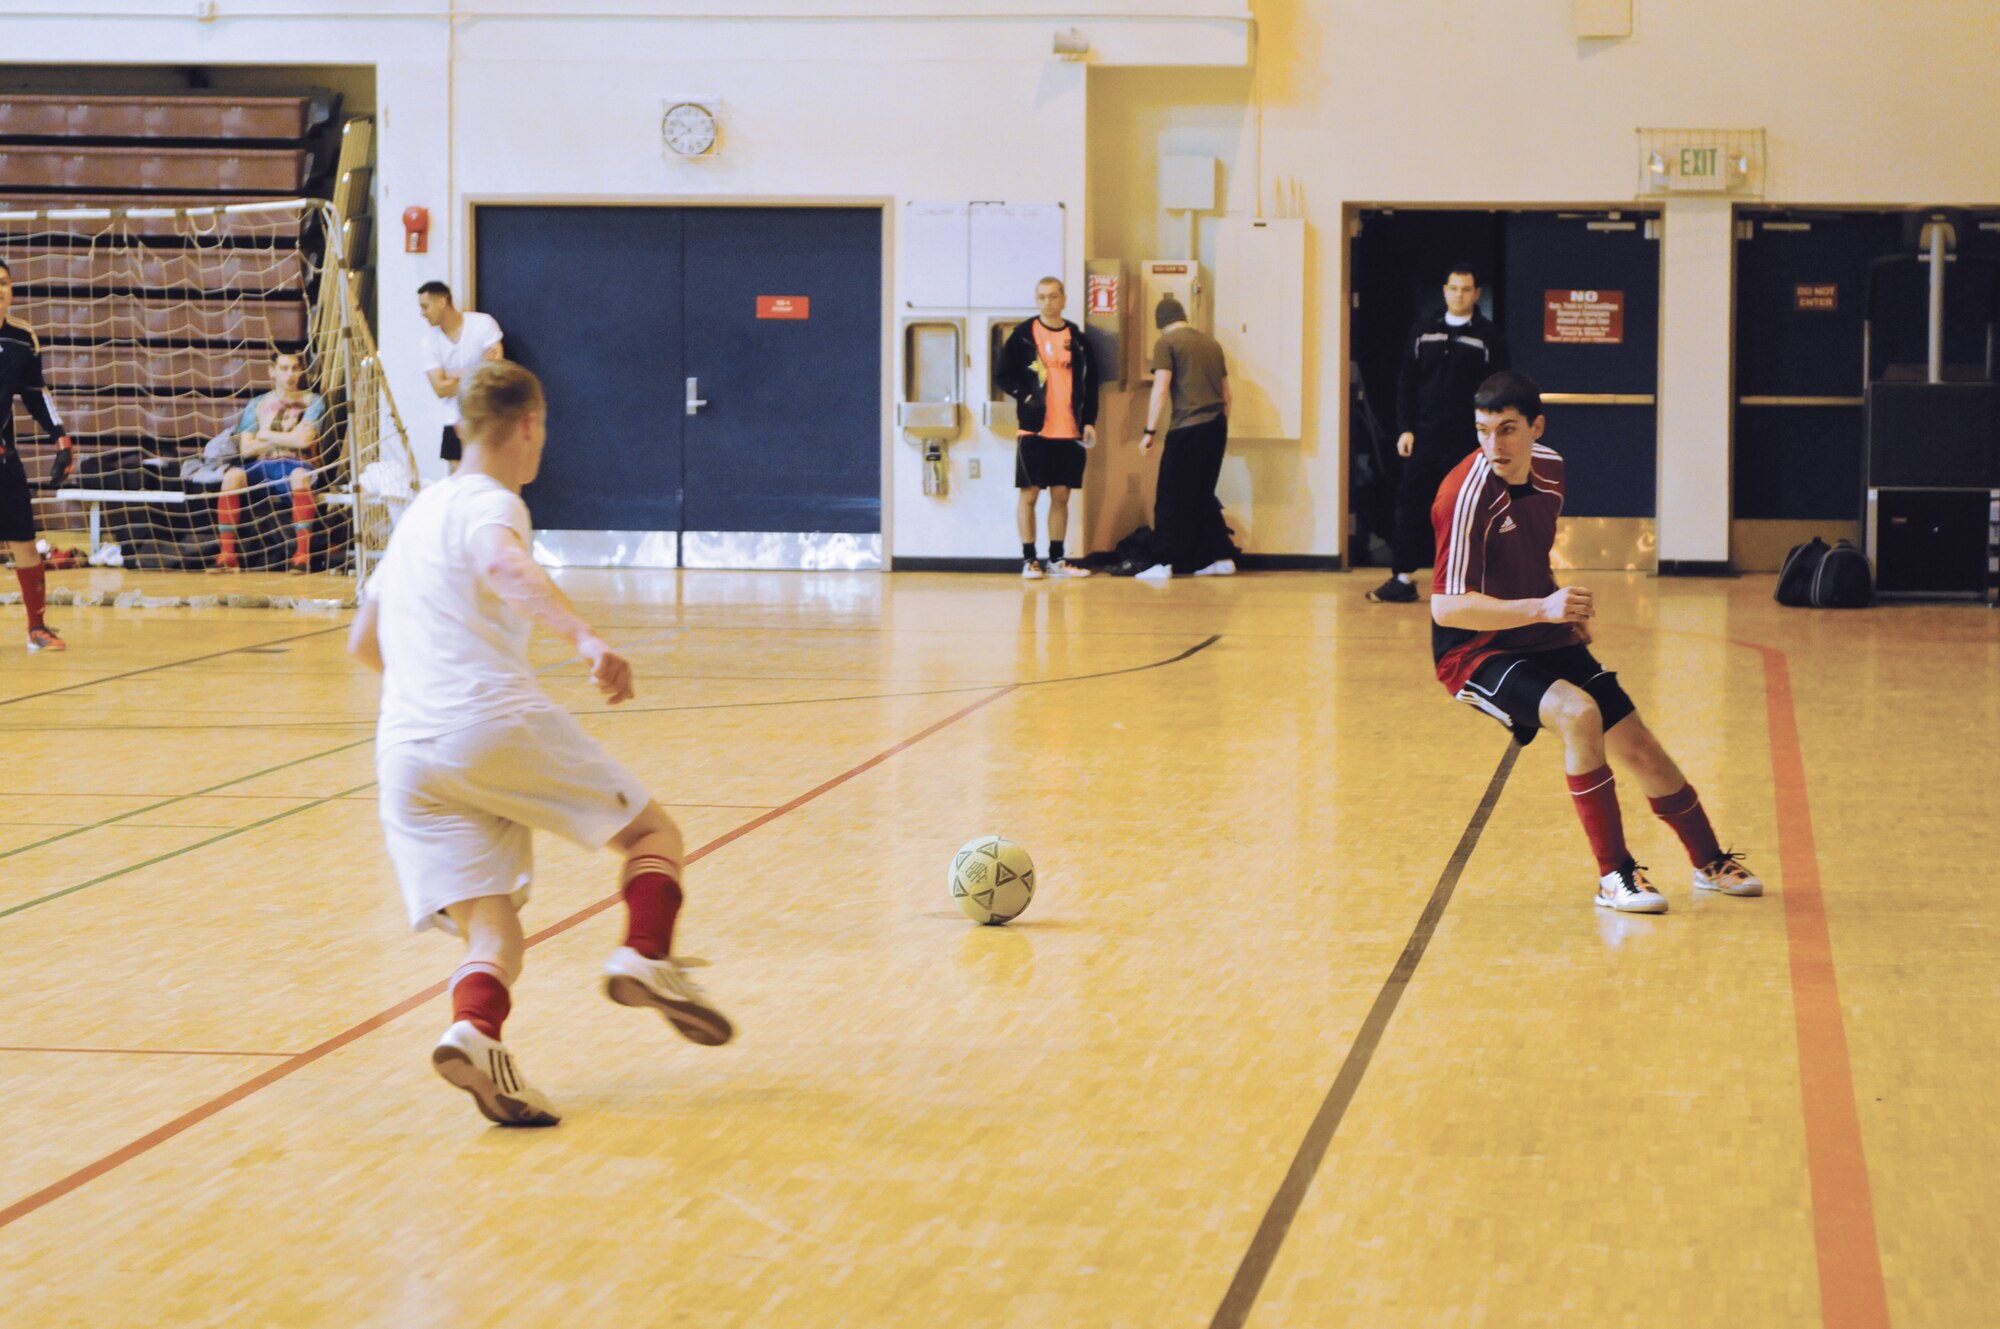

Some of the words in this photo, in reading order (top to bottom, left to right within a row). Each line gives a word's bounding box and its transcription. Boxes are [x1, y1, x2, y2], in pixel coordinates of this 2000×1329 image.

[1681, 148, 1717, 176] EXIT
[1570, 290, 1598, 302] NO
[1797, 286, 1813, 296] DO
[1814, 286, 1834, 296] NOT
[1799, 298, 1832, 306] ENTER
